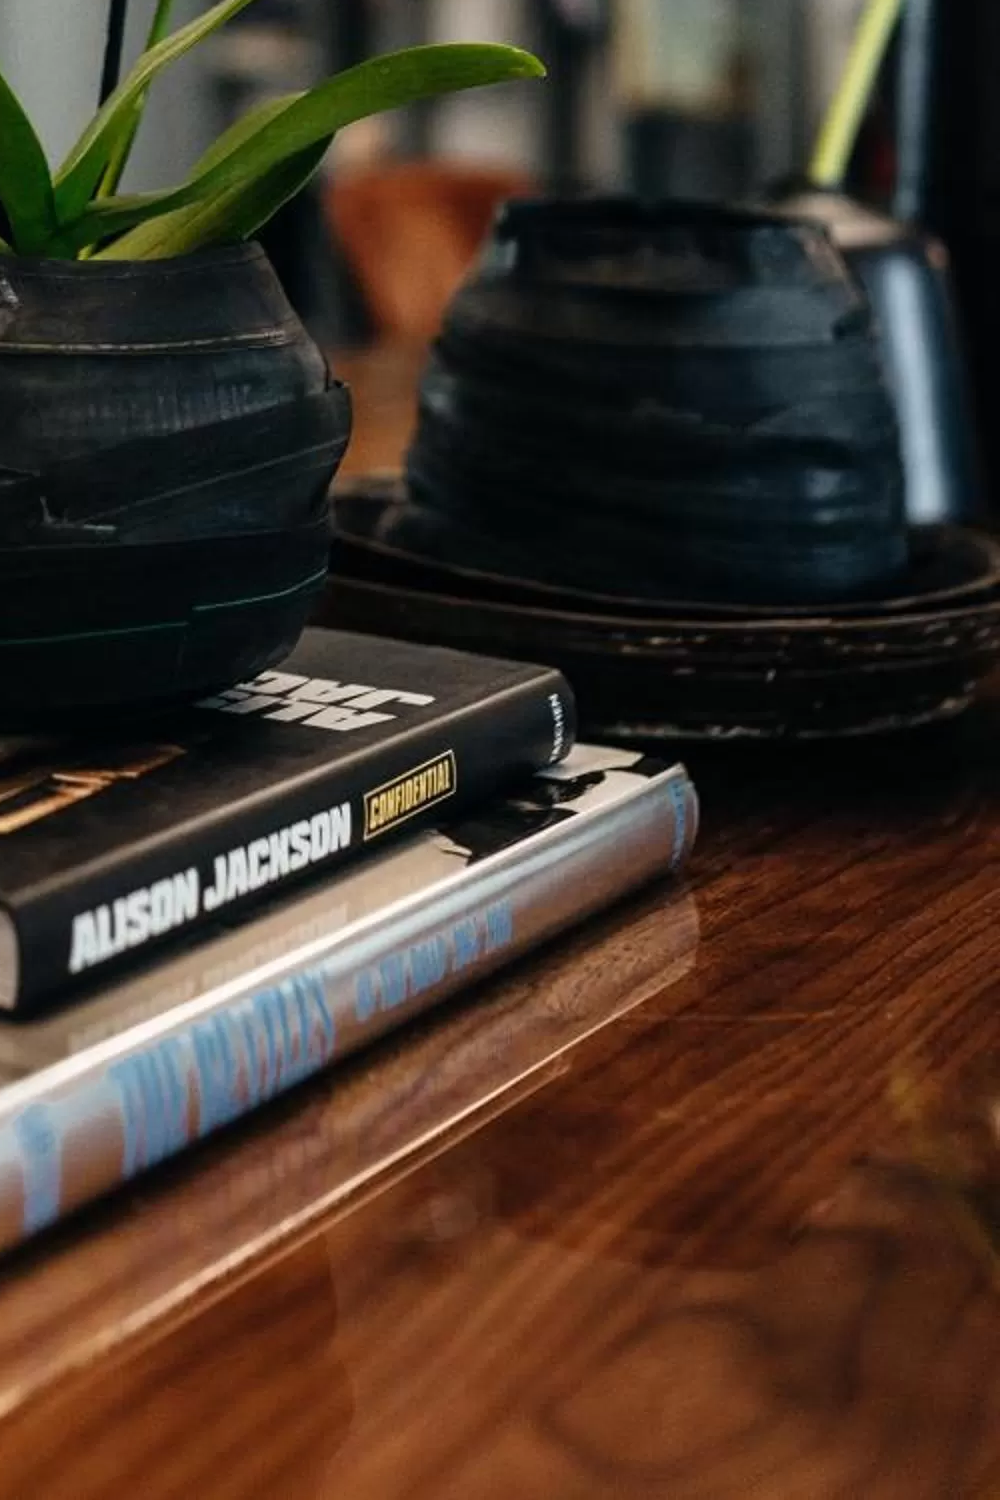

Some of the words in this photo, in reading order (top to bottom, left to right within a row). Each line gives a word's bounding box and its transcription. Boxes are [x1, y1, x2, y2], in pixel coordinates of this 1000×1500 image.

[370, 759, 450, 829] CONFIDENTIAL
[69, 866, 199, 974] ALISON
[203, 801, 350, 911] JACKSON
